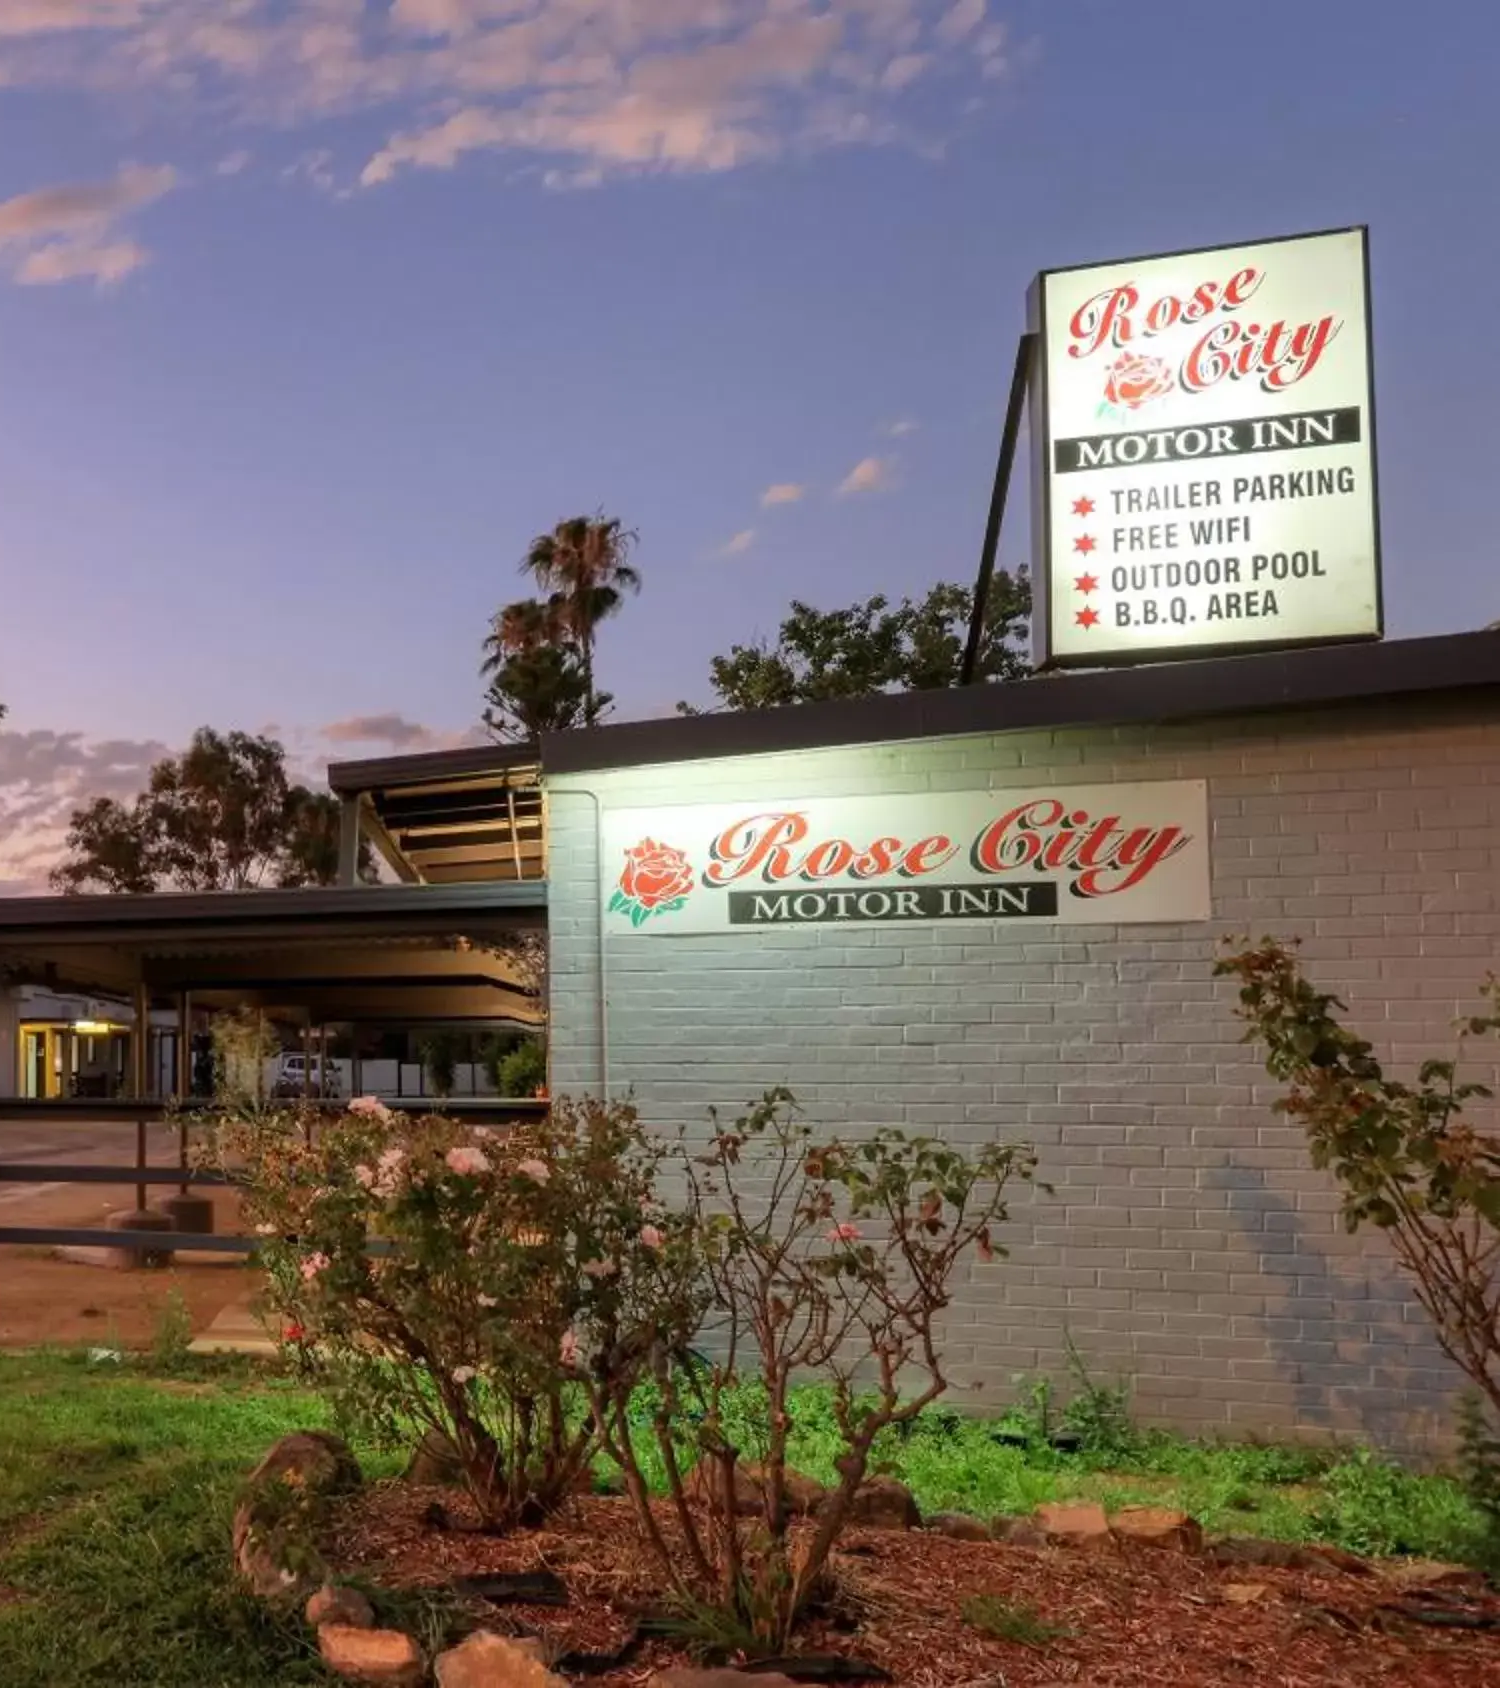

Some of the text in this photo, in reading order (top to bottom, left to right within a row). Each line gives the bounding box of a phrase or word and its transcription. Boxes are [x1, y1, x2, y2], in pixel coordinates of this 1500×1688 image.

[1067, 267, 1266, 359] Rose
[1178, 315, 1344, 395] City
[1076, 414, 1336, 468] MOTOR INN
[1110, 466, 1355, 515] TRAILER PARKING
[1112, 515, 1251, 554] FREE WIFI
[1111, 550, 1327, 593] OUTDOOR POOL
[1115, 589, 1279, 628] B.B.Q. AREA
[702, 799, 1194, 898] Rose City
[752, 888, 1032, 919] MOTOR INN
